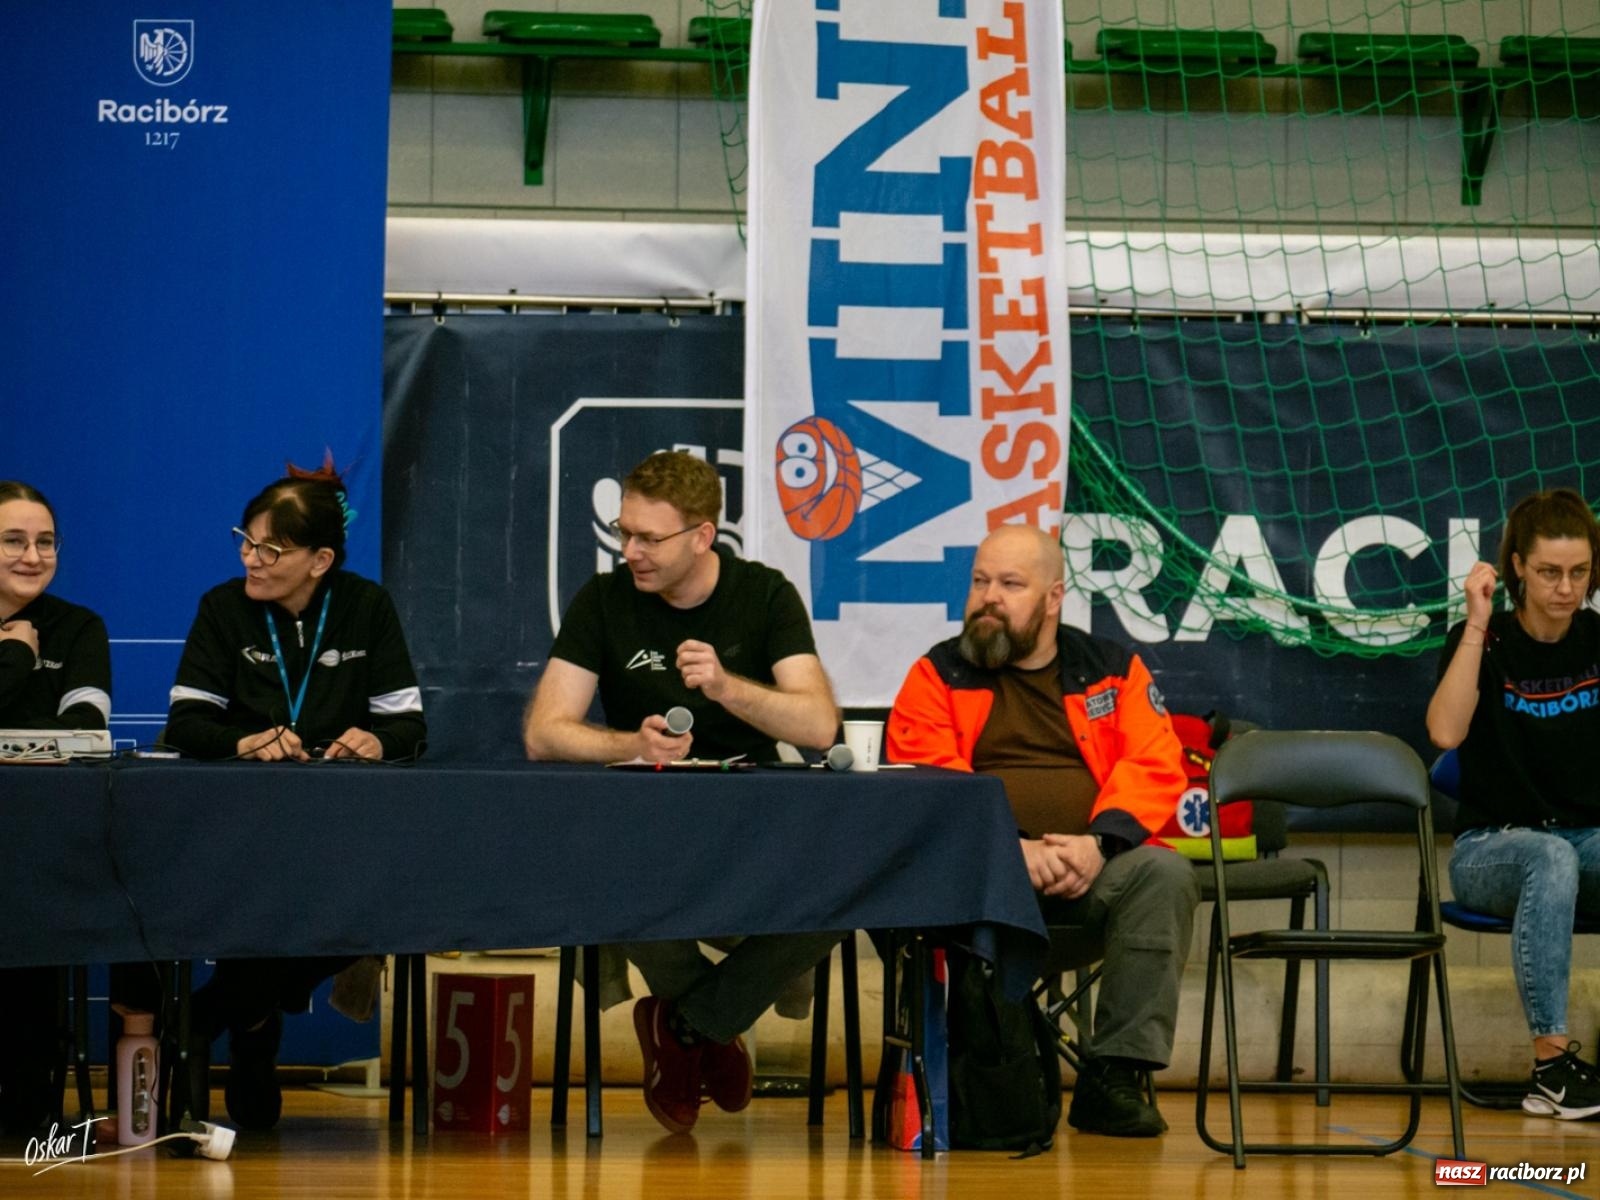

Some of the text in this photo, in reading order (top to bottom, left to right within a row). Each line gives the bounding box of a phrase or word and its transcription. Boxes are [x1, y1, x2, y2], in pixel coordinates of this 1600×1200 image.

[98, 99, 228, 123] Racibórz
[144, 132, 180, 150] 1217
[808, 0, 977, 622] MIN
[973, 1, 1061, 539] ASKETBAL
[1062, 513, 1513, 646] RACI
[1504, 688, 1599, 718] RACIBÓRZ
[436, 991, 475, 1089] 5
[497, 992, 525, 1092] 5
